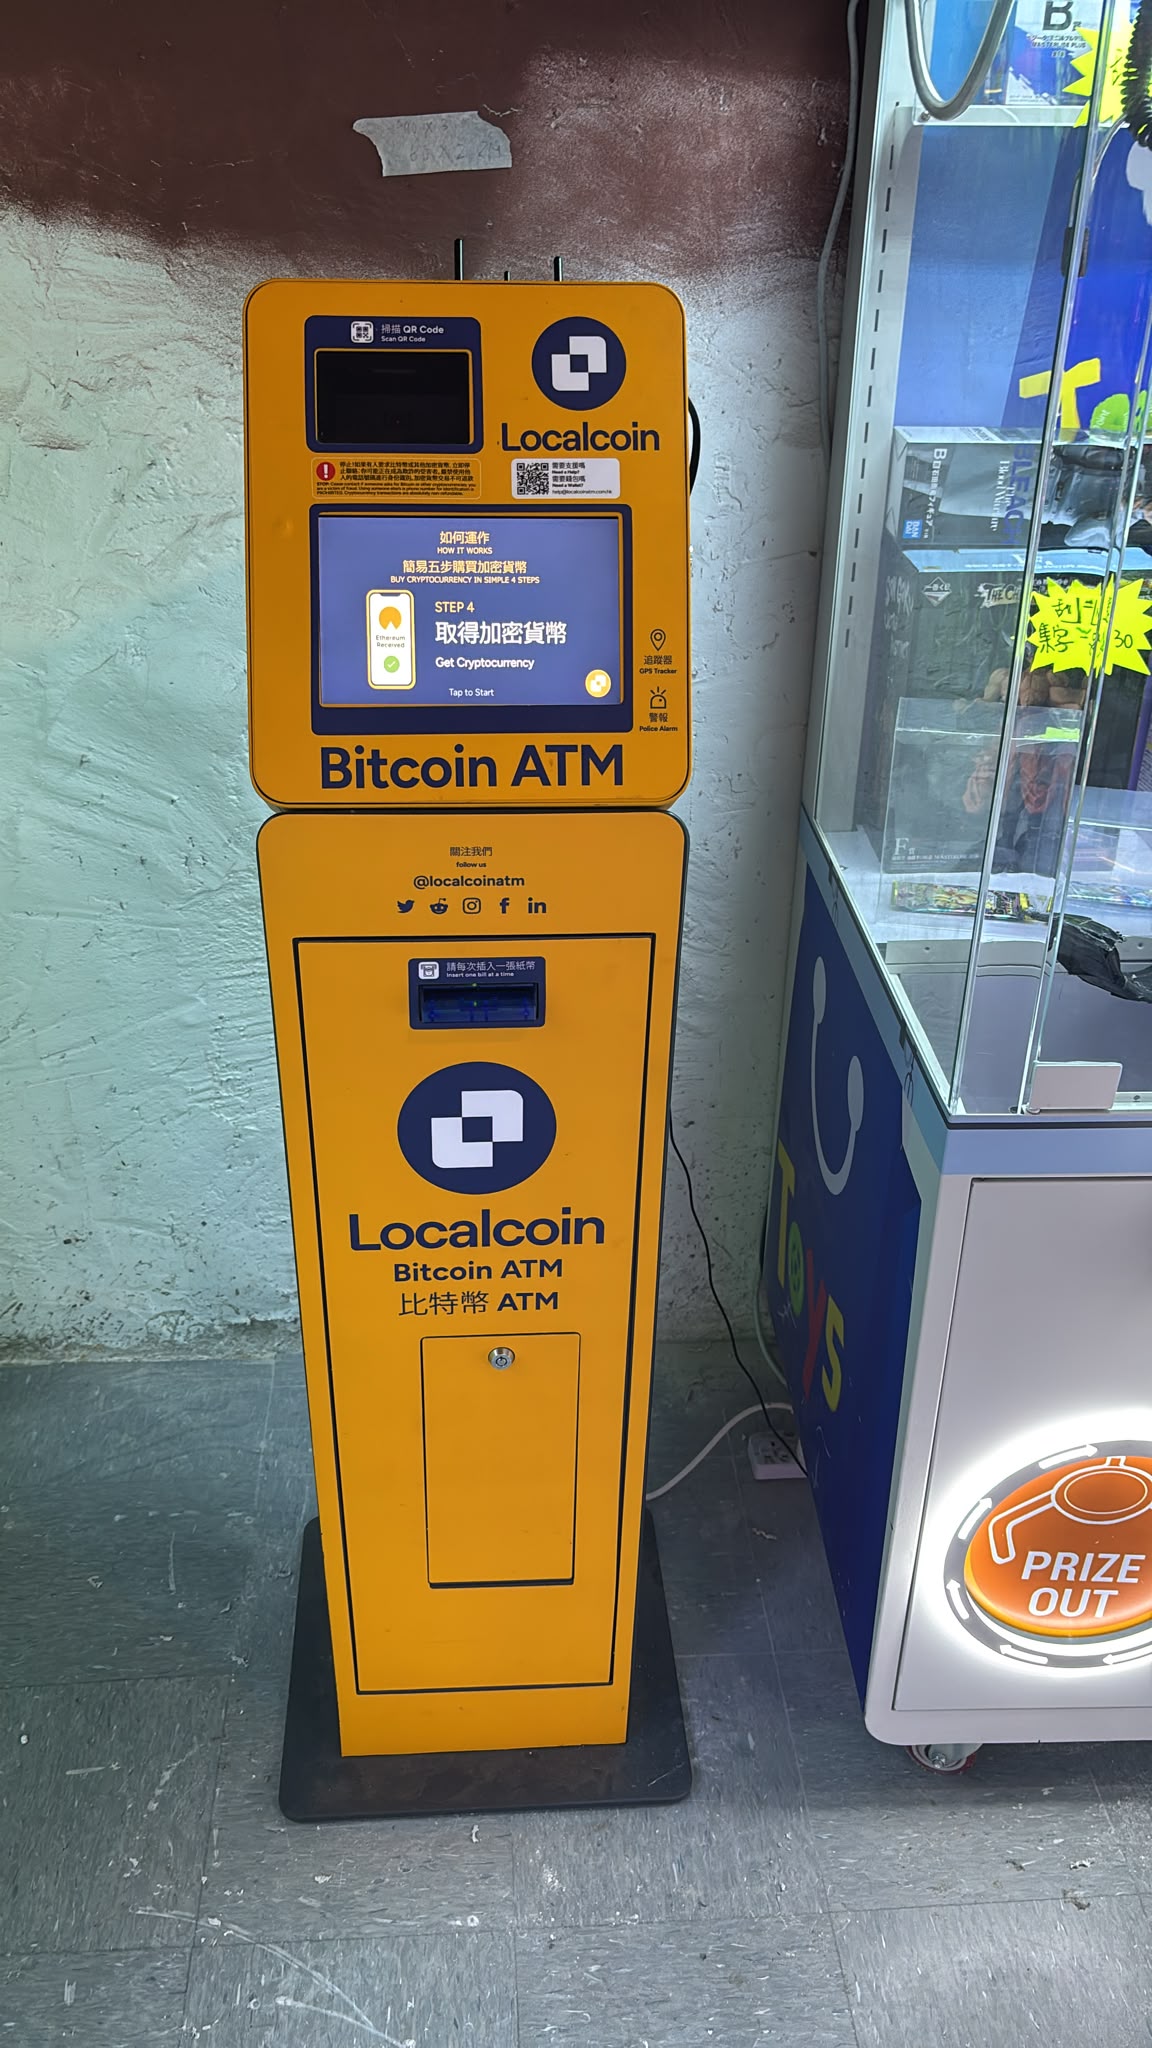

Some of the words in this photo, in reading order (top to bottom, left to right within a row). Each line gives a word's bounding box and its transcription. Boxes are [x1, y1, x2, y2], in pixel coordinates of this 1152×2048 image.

[381, 324, 400, 334] 掃描
[403, 325, 417, 334] QR
[419, 325, 444, 334] Code
[501, 421, 660, 451] Localcoin
[1000, 444, 1035, 545] BLEACH
[439, 531, 490, 545] 如何運作
[466, 547, 493, 555] WORKS
[402, 559, 527, 574] 簡易五步購買加密貨幣
[406, 576, 473, 584] CRYPTOCURRENCY
[484, 576, 510, 584] SIMPLE
[517, 576, 540, 584] STEPS
[434, 602, 465, 613] STEP
[466, 602, 475, 613] 4
[435, 621, 567, 645] 取得加密貨幣
[435, 656, 454, 668] Get
[456, 657, 535, 670] Cryptocurrency
[449, 688, 463, 697] Tap
[464, 688, 473, 696] to
[474, 688, 495, 697] Start
[321, 744, 497, 789] Bitcoin
[511, 744, 623, 786] ATM
[450, 846, 493, 857] 關注我們
[413, 875, 525, 890] @localcoinatm
[446, 961, 536, 972] 請每次插入一張紙幣
[349, 1206, 605, 1251] Localcoin
[394, 1260, 492, 1282] Bitcoin
[500, 1259, 563, 1279] ATM
[777, 1138, 844, 1412] Toys
[398, 1290, 489, 1316] 比特幣
[497, 1292, 559, 1312] ATM
[1021, 1551, 1146, 1583] PRIZE
[1028, 1587, 1119, 1618] OUT
